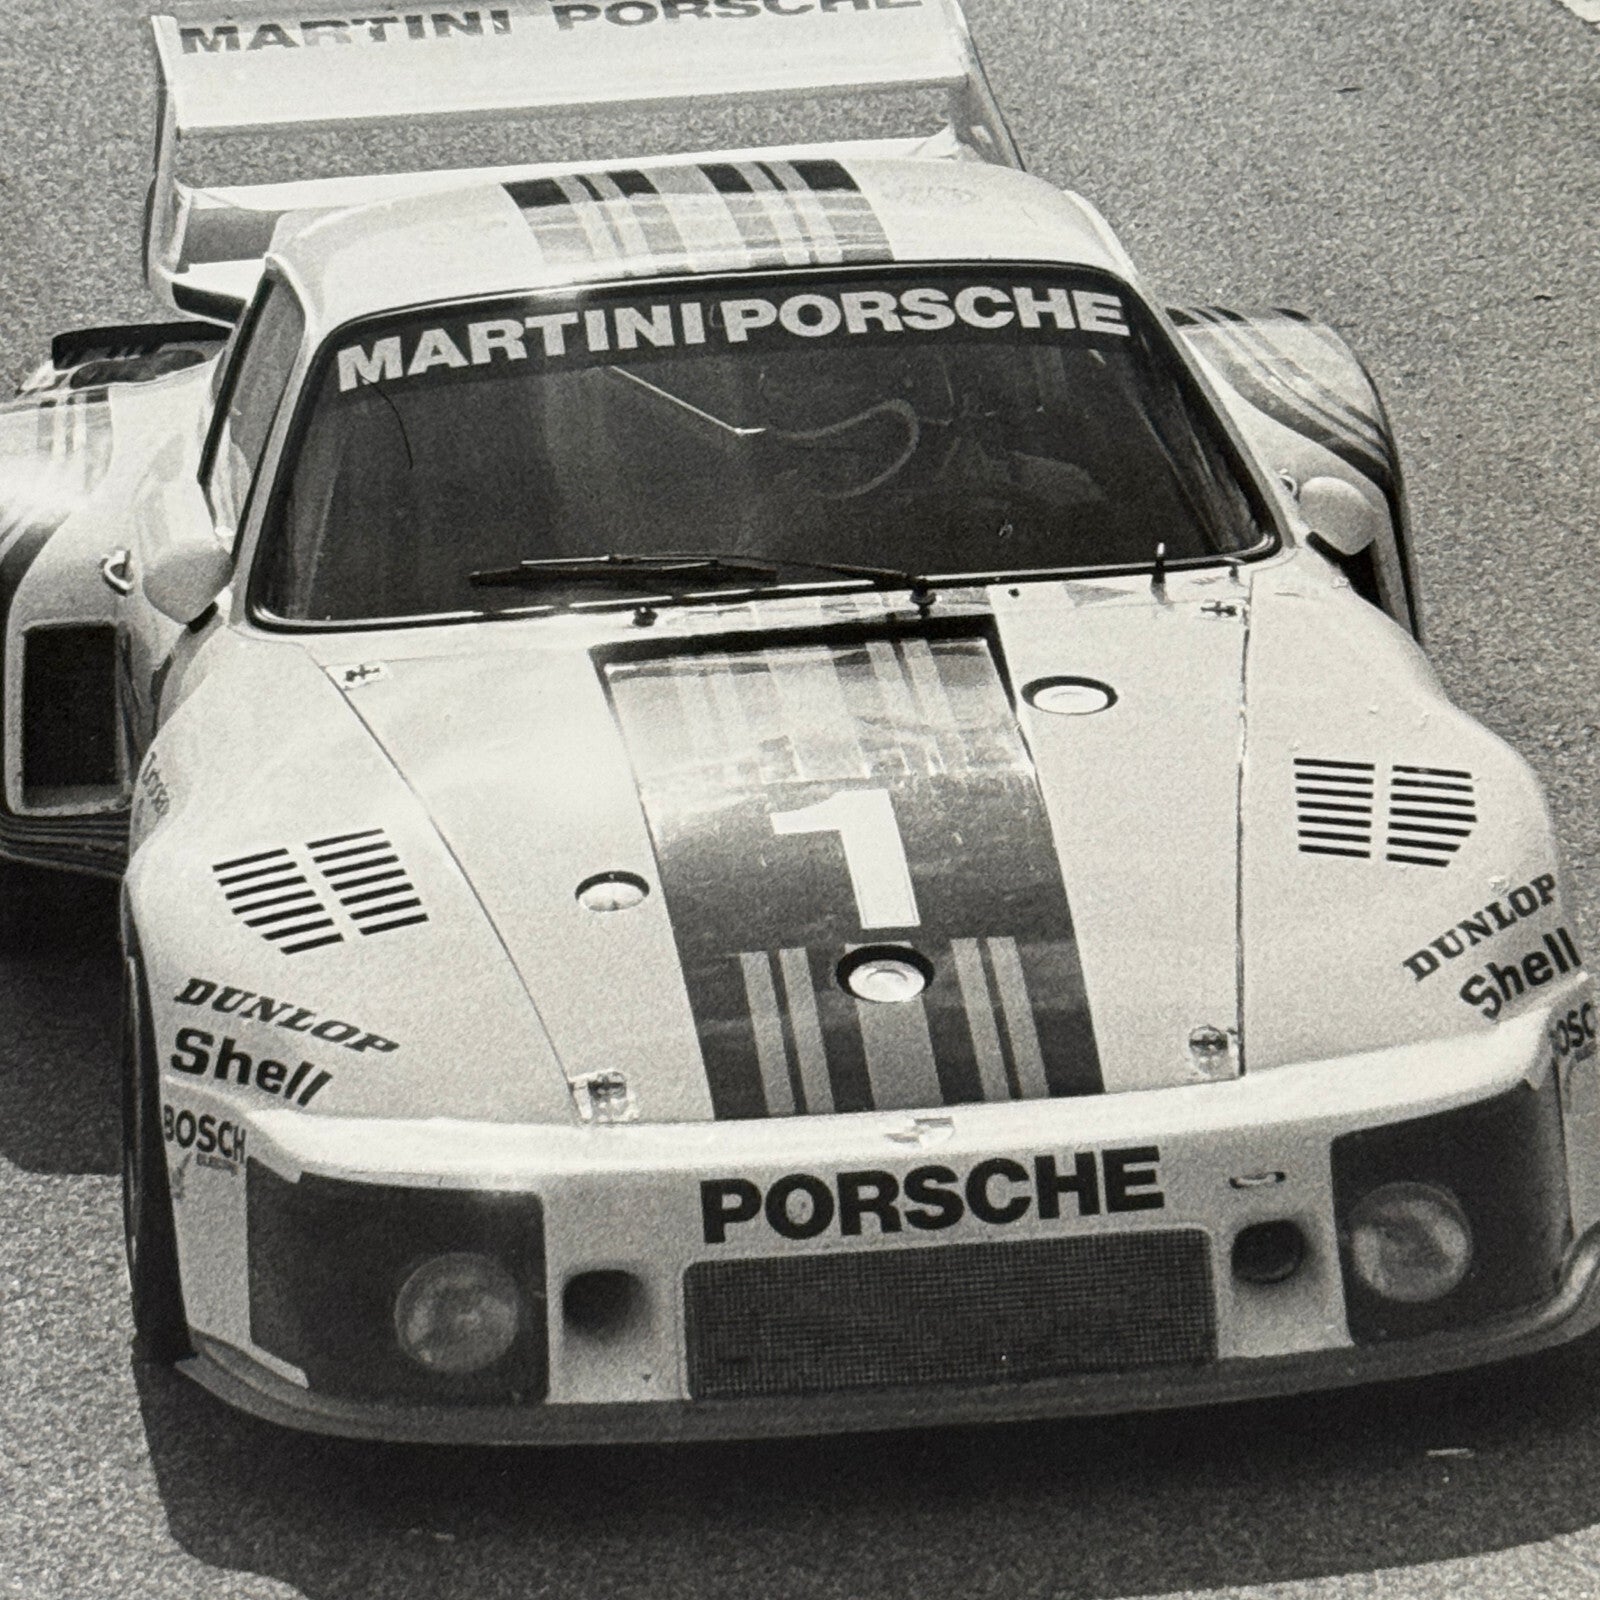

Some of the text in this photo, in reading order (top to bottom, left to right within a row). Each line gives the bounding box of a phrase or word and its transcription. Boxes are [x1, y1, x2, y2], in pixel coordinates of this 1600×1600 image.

[180, 9, 511, 53] MARTINI
[336, 286, 1131, 393] MARTINI PORSCHE
[770, 788, 922, 931] 1
[1402, 872, 1557, 982] DUNLOP
[1459, 926, 1582, 1020] Shell
[173, 977, 400, 1053] DUNLOP
[170, 1027, 333, 1107] Shell
[163, 1103, 247, 1165] BOSCH
[699, 1145, 1166, 1244] PORSCHE
